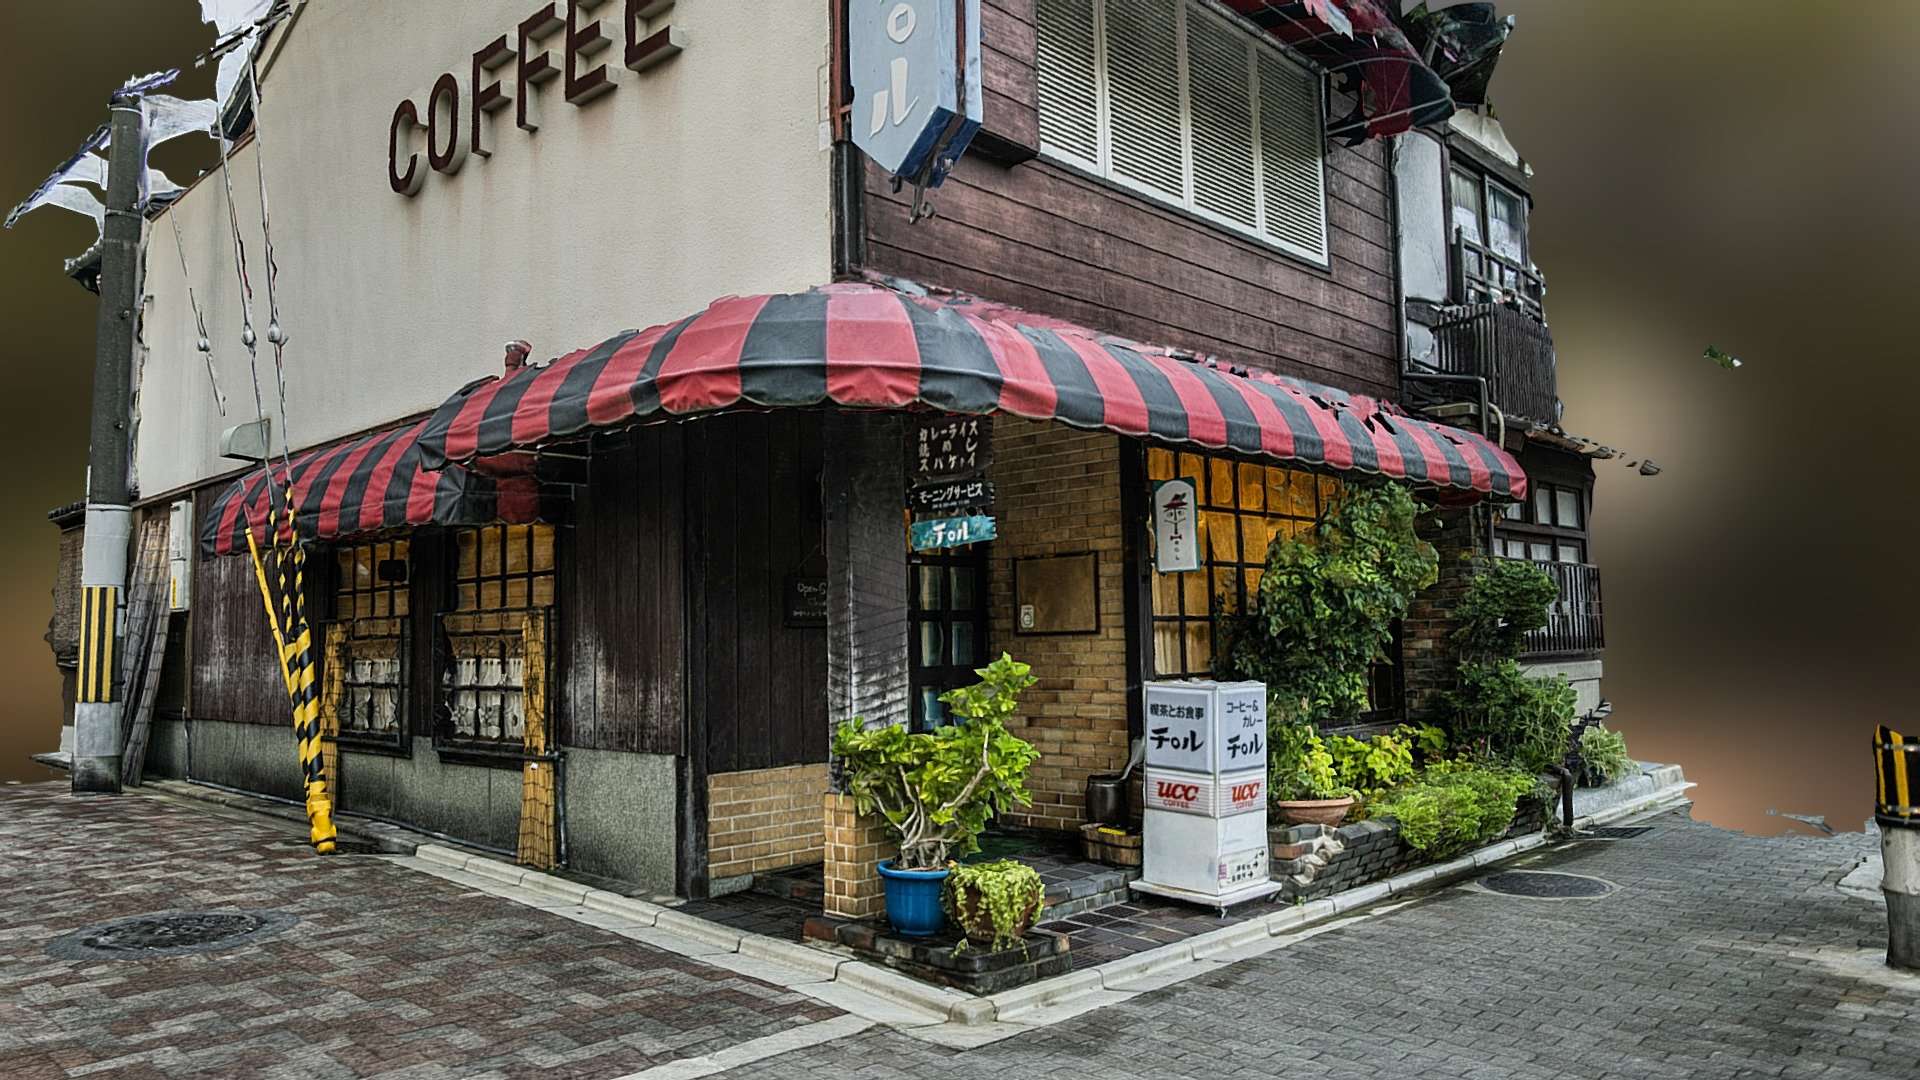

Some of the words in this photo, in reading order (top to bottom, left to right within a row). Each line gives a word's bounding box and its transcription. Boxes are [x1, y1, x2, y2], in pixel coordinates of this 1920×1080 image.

[388, 0, 682, 196] COFFEE
[919, 482, 983, 504] モーニングサービス
[932, 520, 970, 545] チロル
[1150, 703, 1204, 720] 喫茶とお食事
[1242, 714, 1263, 728] カレー
[1149, 726, 1205, 752] チロル
[1226, 733, 1264, 759] チロル
[1156, 781, 1199, 801] UCC
[1231, 782, 1261, 802] UCC
[1163, 799, 1190, 809] COFFEE
